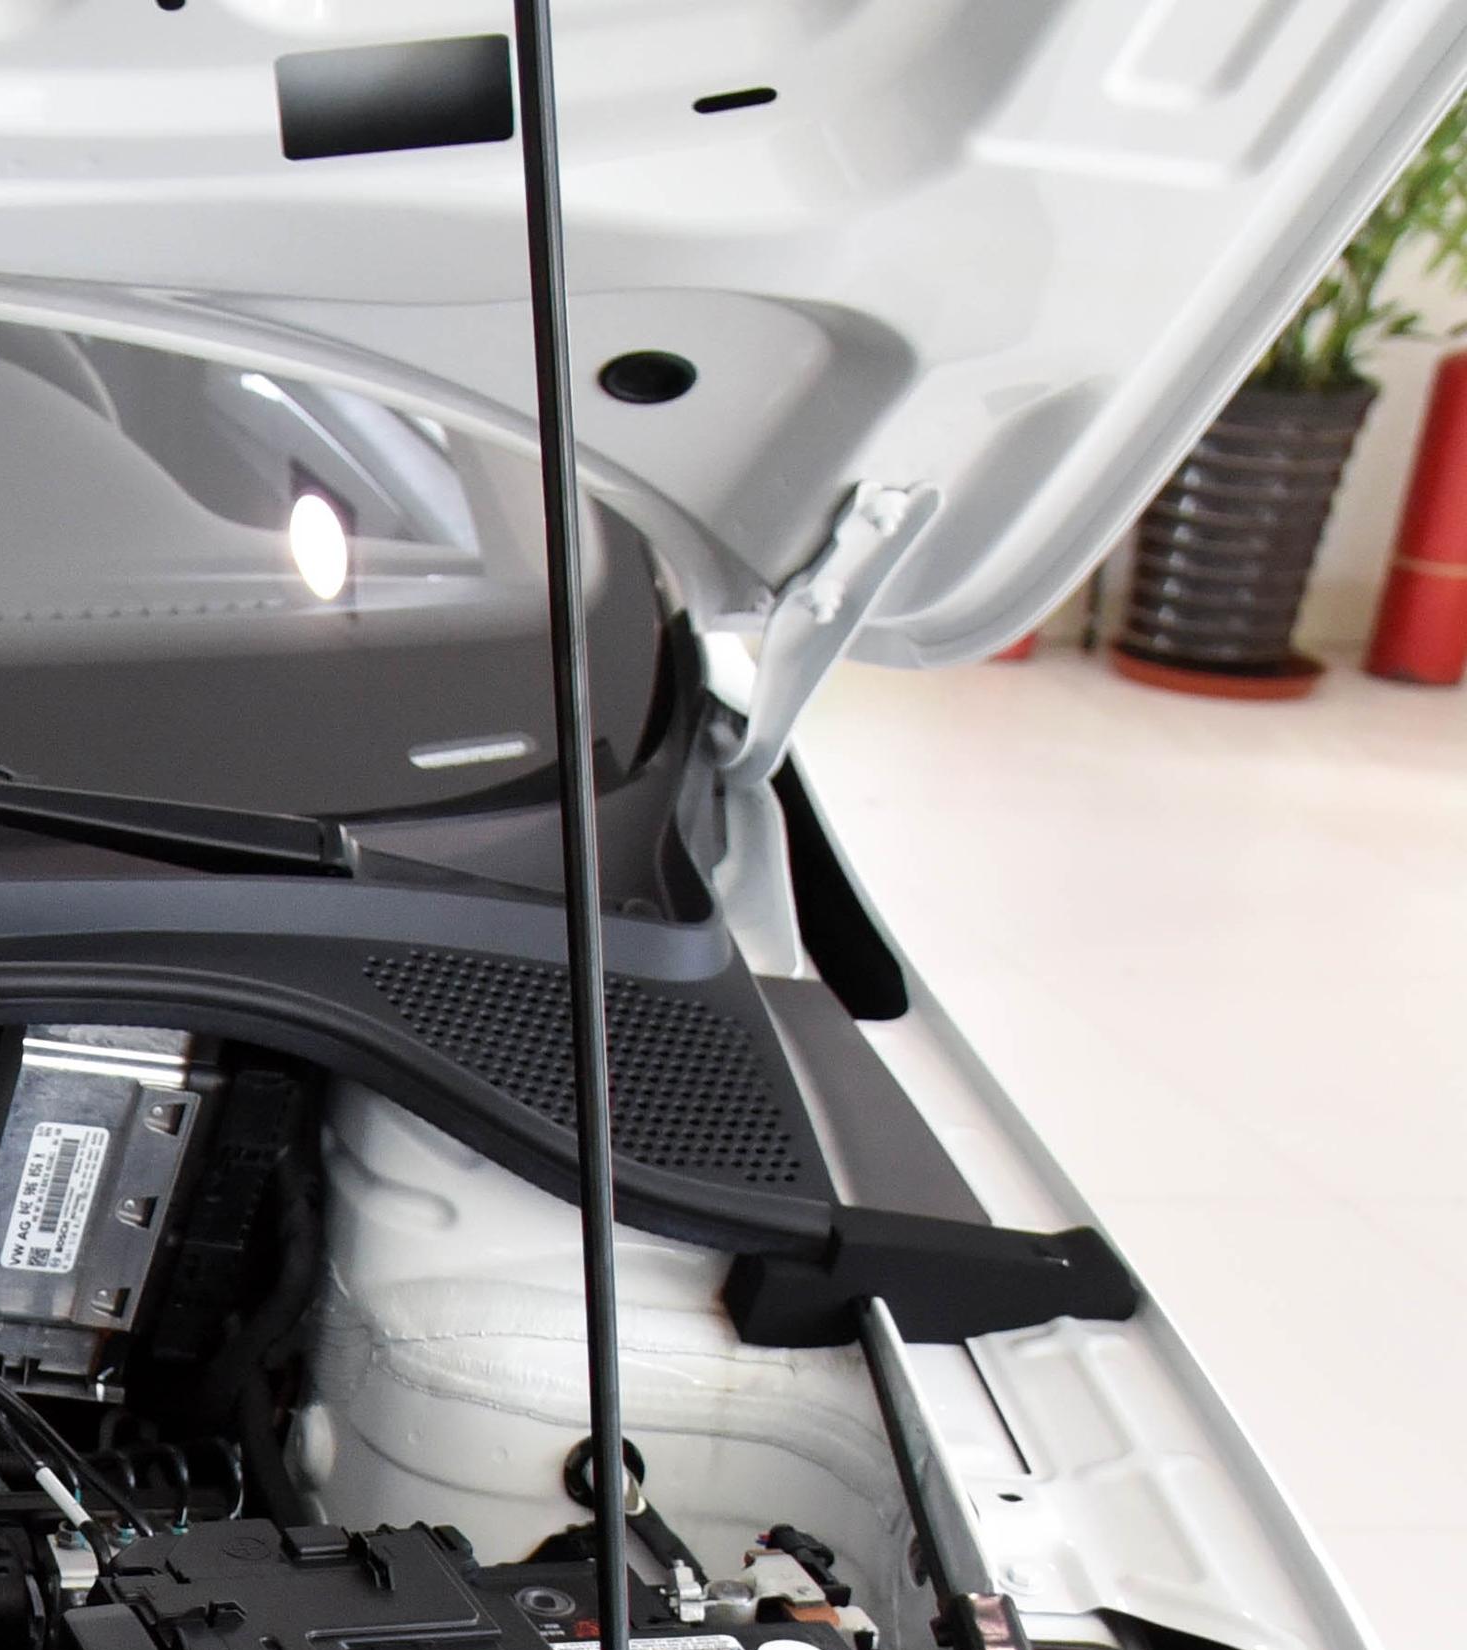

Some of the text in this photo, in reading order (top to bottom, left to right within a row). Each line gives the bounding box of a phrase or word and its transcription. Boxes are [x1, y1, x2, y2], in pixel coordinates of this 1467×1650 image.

[9, 1243, 25, 1265] VW
[18, 1221, 31, 1240] AG
[55, 1221, 70, 1252] BOSCH
